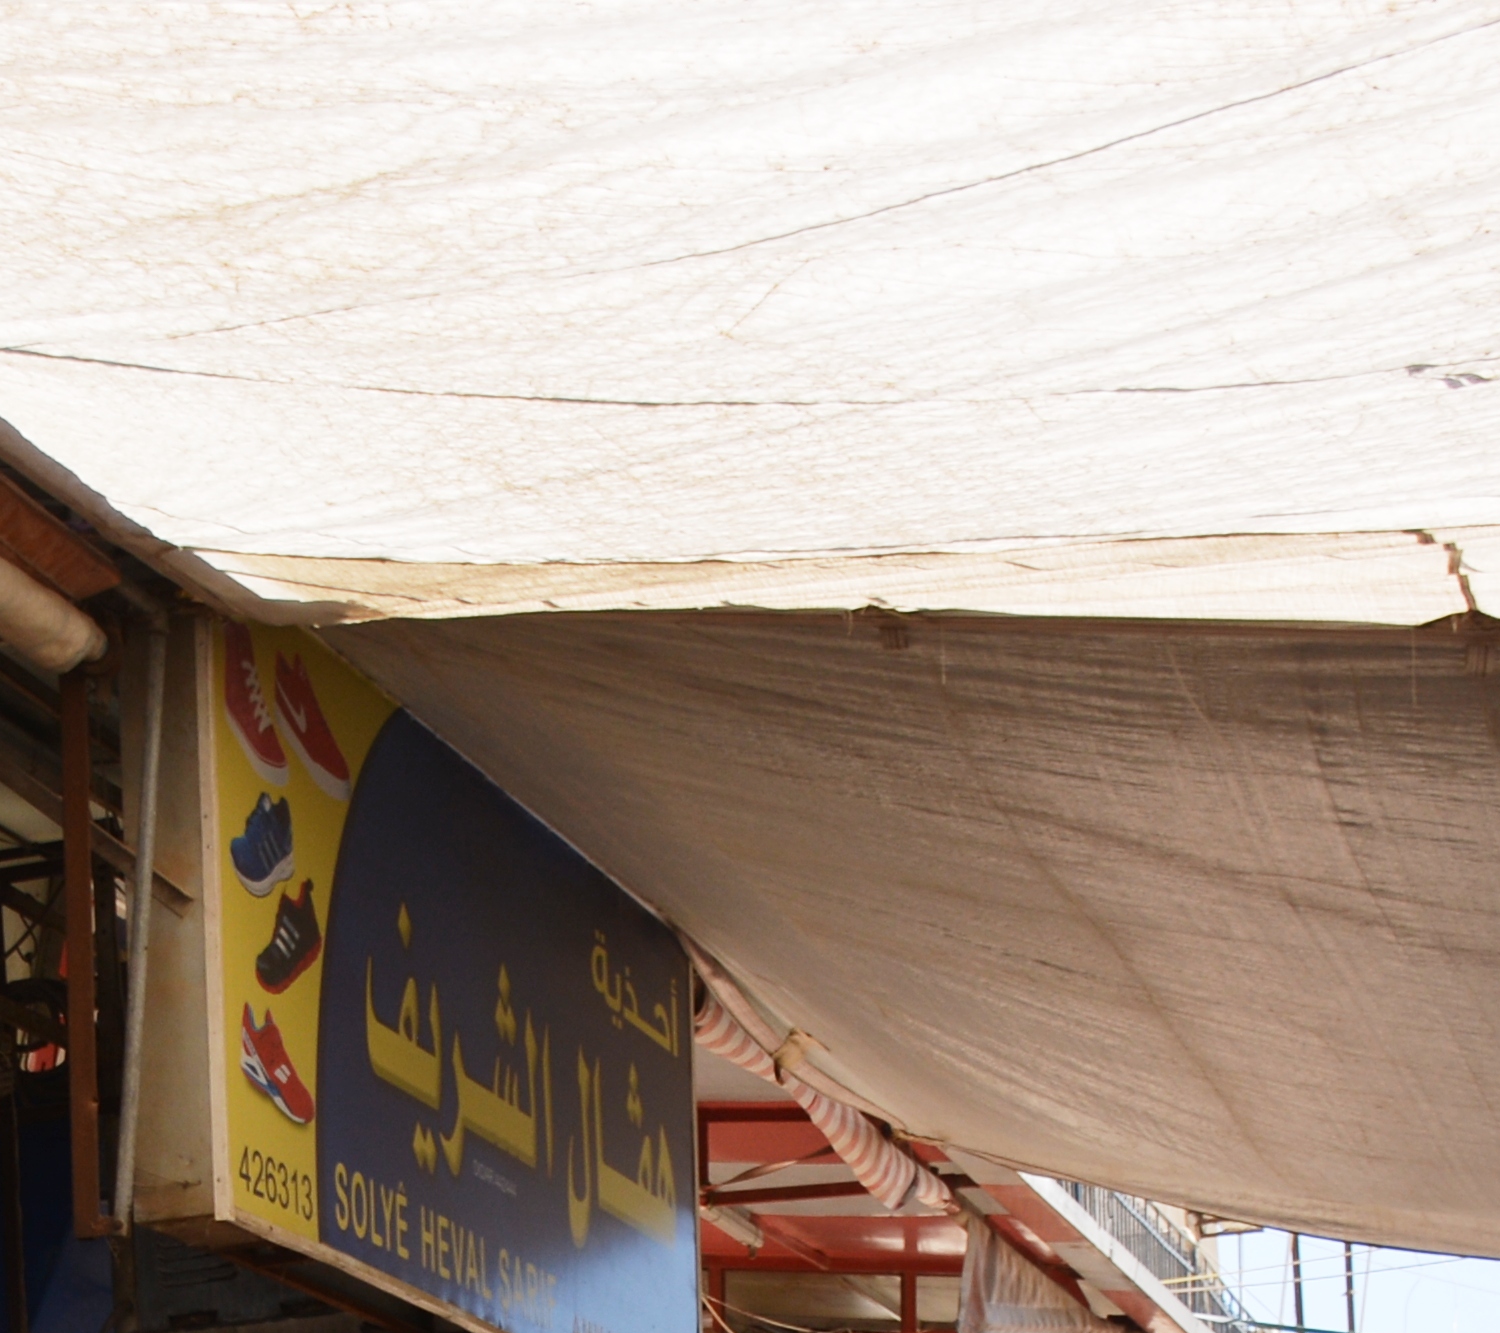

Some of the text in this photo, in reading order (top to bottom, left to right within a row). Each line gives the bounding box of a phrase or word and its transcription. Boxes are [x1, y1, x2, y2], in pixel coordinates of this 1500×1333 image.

[366, 900, 554, 1180] الشريف
[238, 1146, 314, 1221] 426313
[420, 1205, 492, 1300] HEVAL
